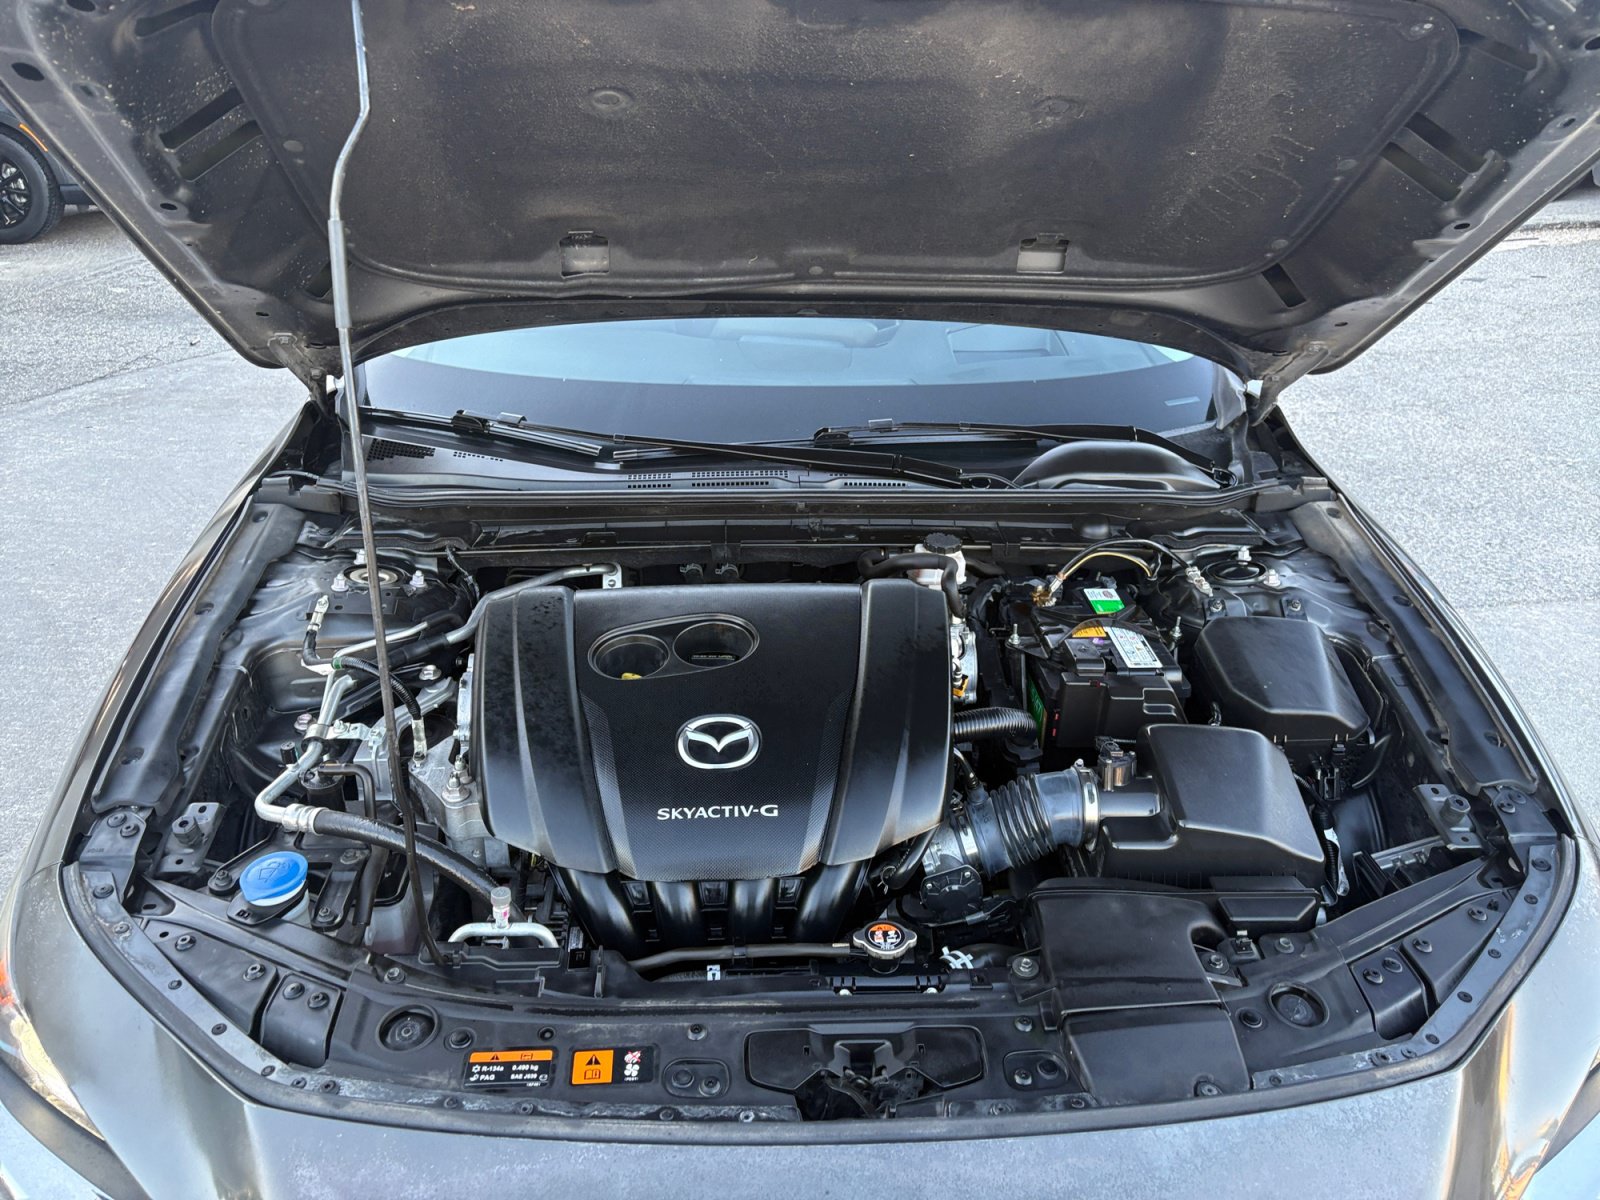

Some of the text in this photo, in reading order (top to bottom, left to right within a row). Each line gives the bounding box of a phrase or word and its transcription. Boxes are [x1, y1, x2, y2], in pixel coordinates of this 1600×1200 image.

[656, 804, 779, 821] SKYACTIV-G
[530, 1063, 539, 1072] kg
[479, 1074, 496, 1082] PAG
